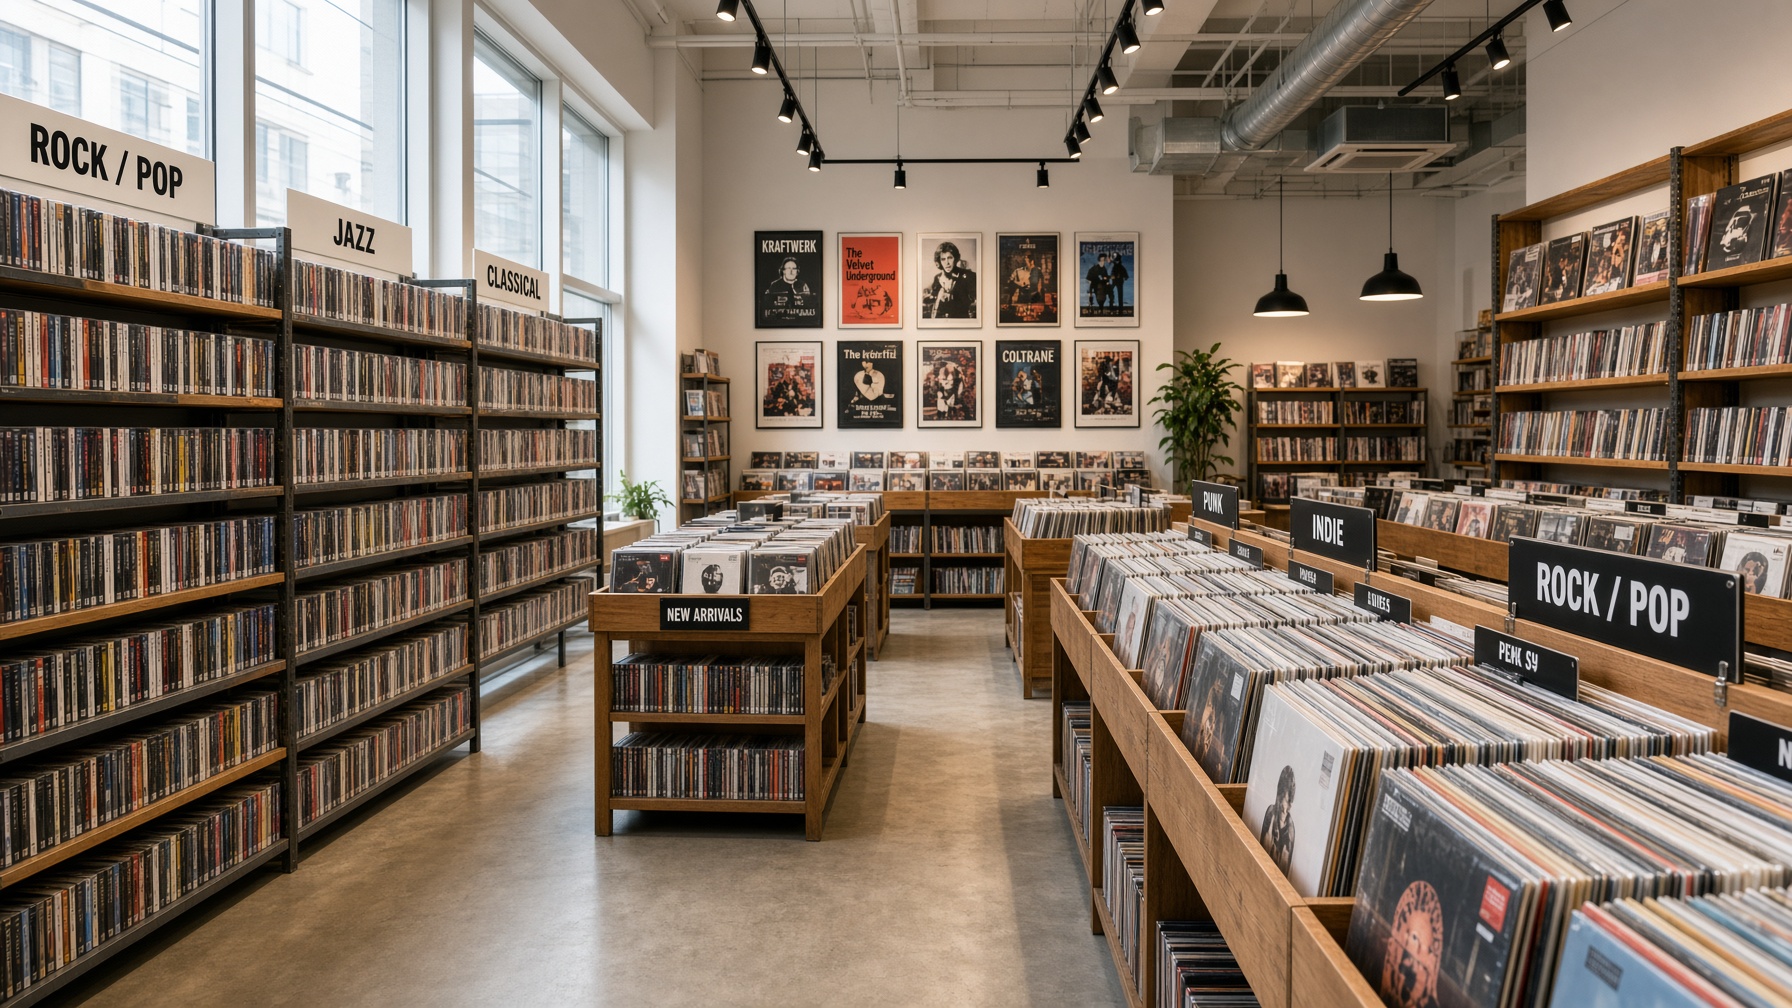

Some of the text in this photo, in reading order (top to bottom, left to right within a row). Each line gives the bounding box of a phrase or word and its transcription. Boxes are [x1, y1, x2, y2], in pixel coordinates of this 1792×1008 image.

[30, 122, 183, 199] ROCK / POP
[333, 217, 376, 255] JAZZ
[762, 239, 817, 253] KRAFTWERK
[846, 247, 863, 259] The
[846, 259, 874, 271] Velvet
[487, 264, 541, 301] CLASSICAL
[846, 270, 896, 284] Underground
[843, 349, 861, 359] The
[1002, 349, 1055, 363] COLTRANE
[1203, 490, 1224, 515] PUNK
[1312, 513, 1344, 547] INDIE
[1536, 561, 1690, 638] ROCK / POP
[667, 607, 743, 622] NEW ARRIVALS
